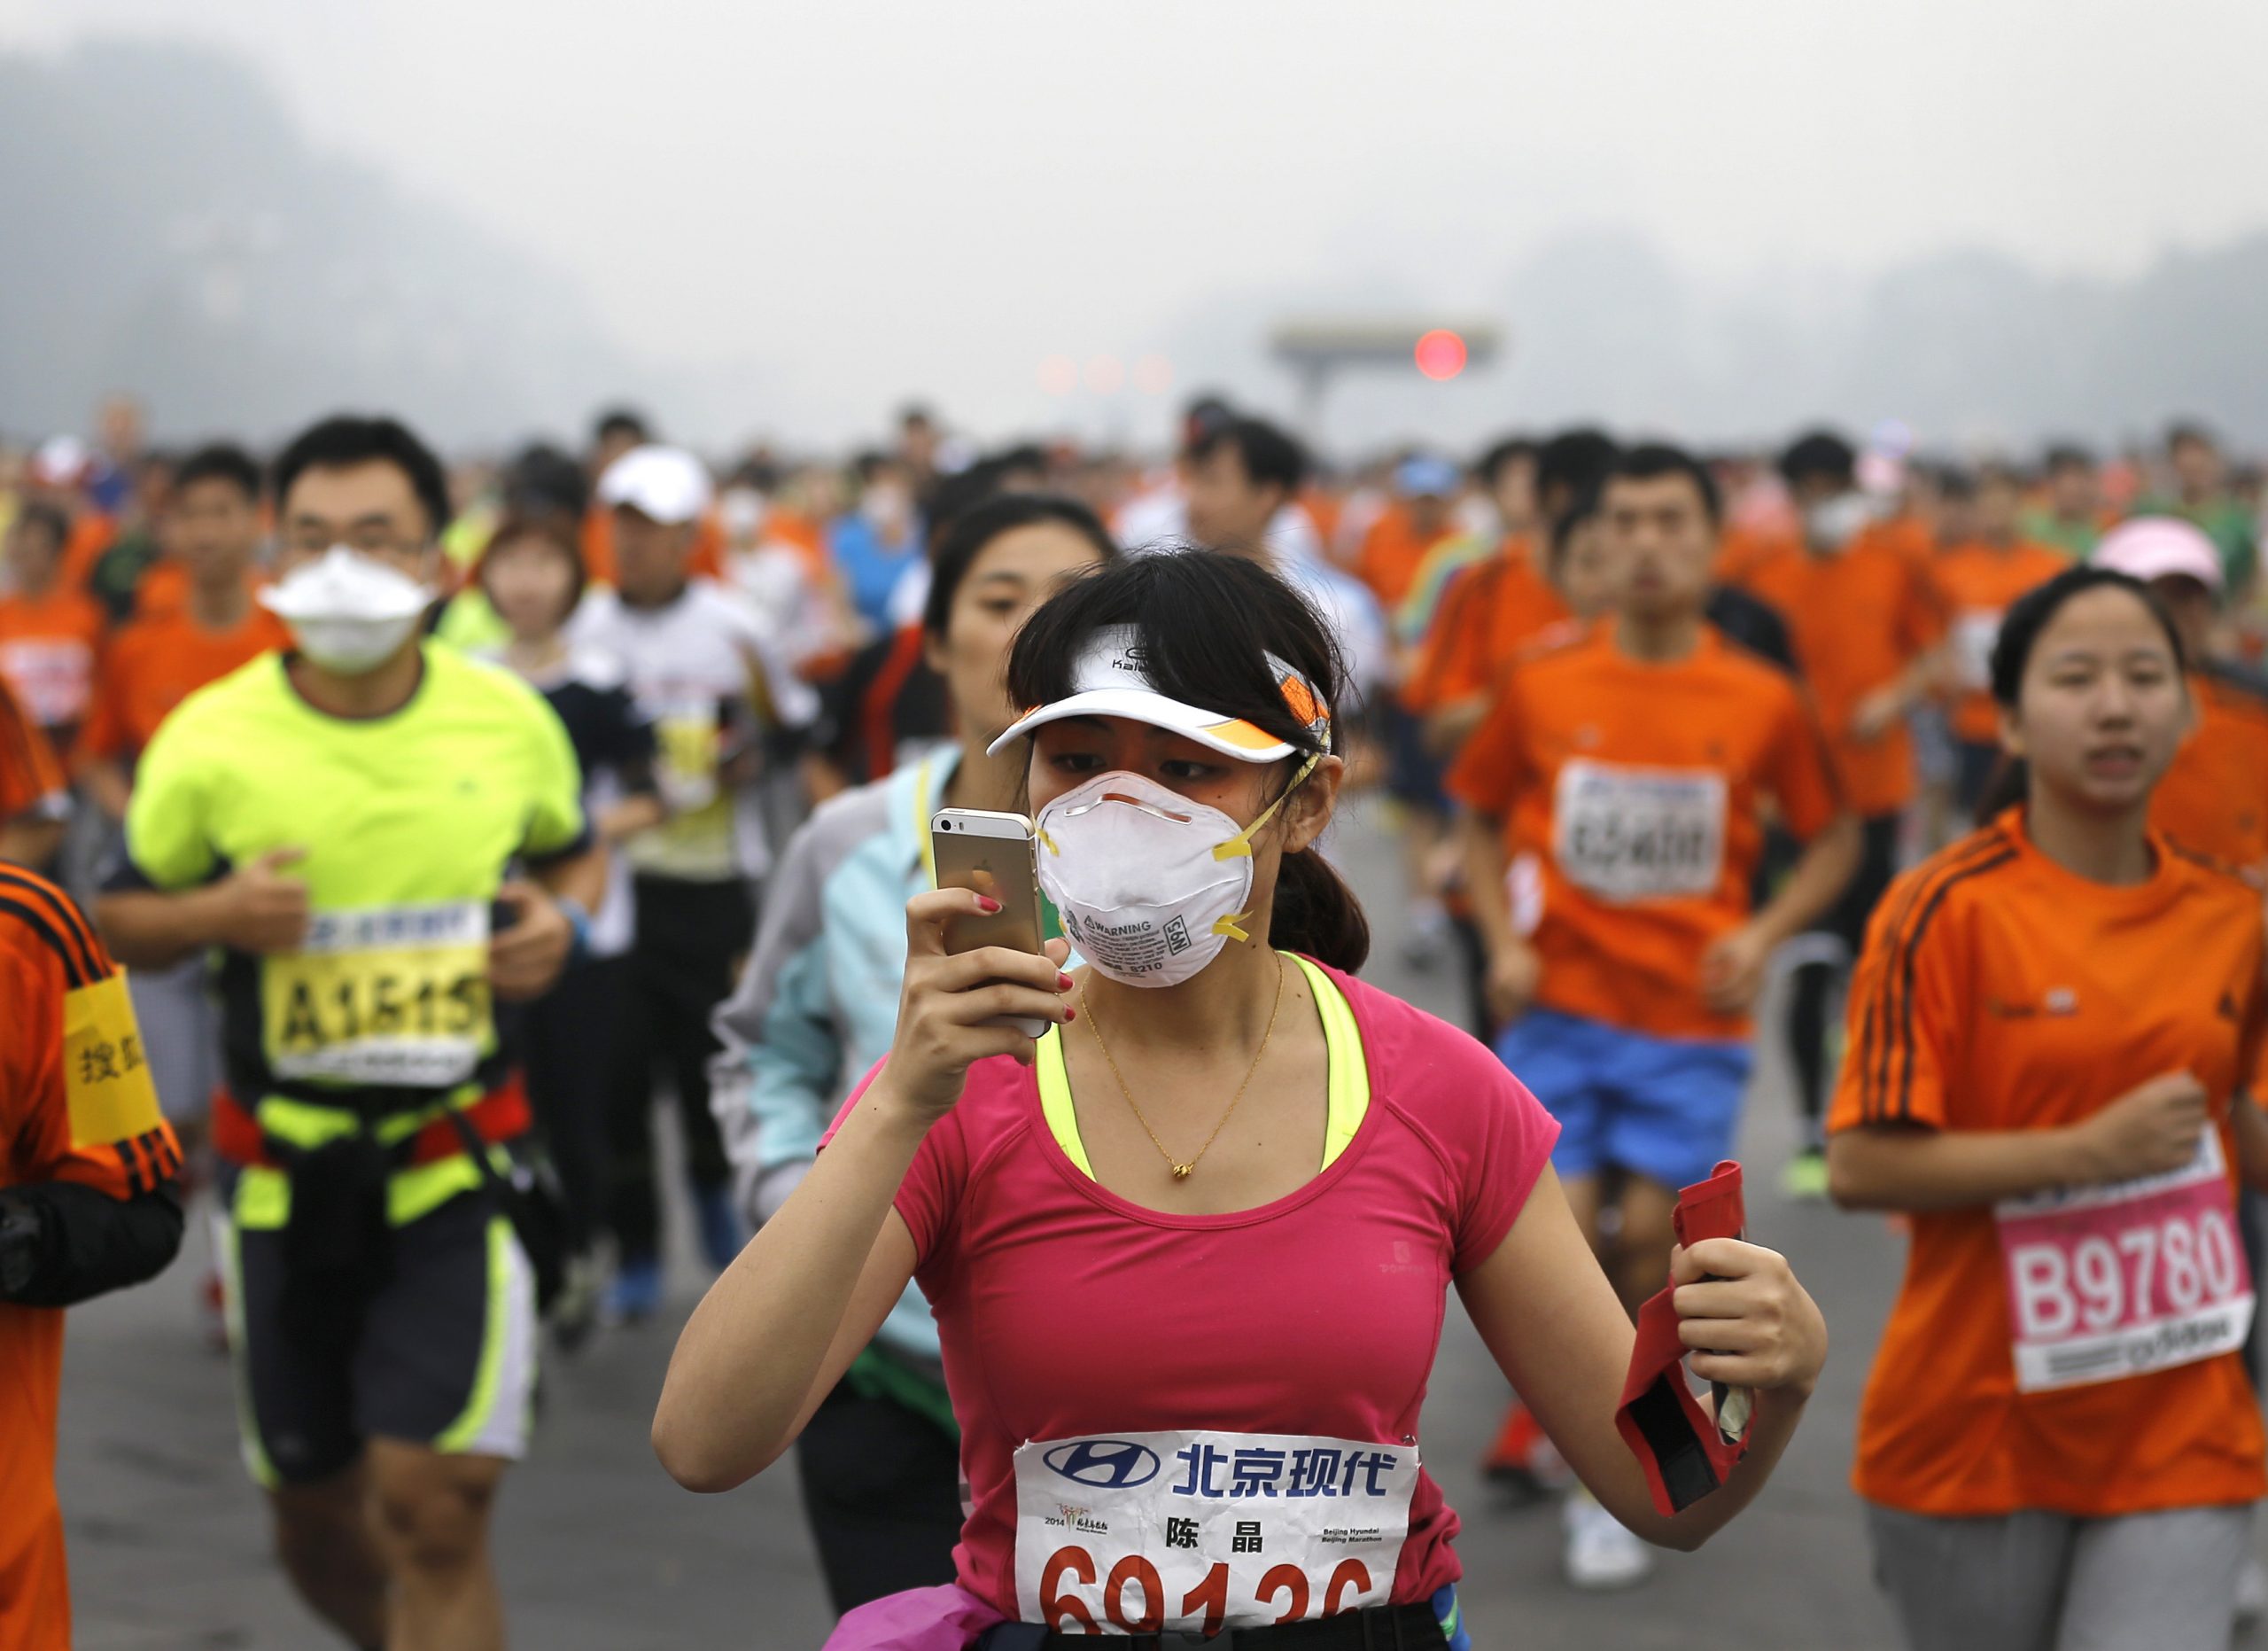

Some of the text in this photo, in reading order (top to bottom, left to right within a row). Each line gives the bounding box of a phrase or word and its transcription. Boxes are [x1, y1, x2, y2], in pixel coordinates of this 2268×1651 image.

[1094, 921, 1152, 937] WARNING
[1168, 920, 1189, 953] N95
[1130, 962, 1163, 973] 8210
[2010, 1208, 2239, 1339] B9780
[1172, 1443, 1398, 1499] 北京现代
[1045, 1517, 1065, 1527] 2014
[1350, 1527, 1379, 1536] Hyundai
[1165, 1516, 1263, 1553] 陈 晶
